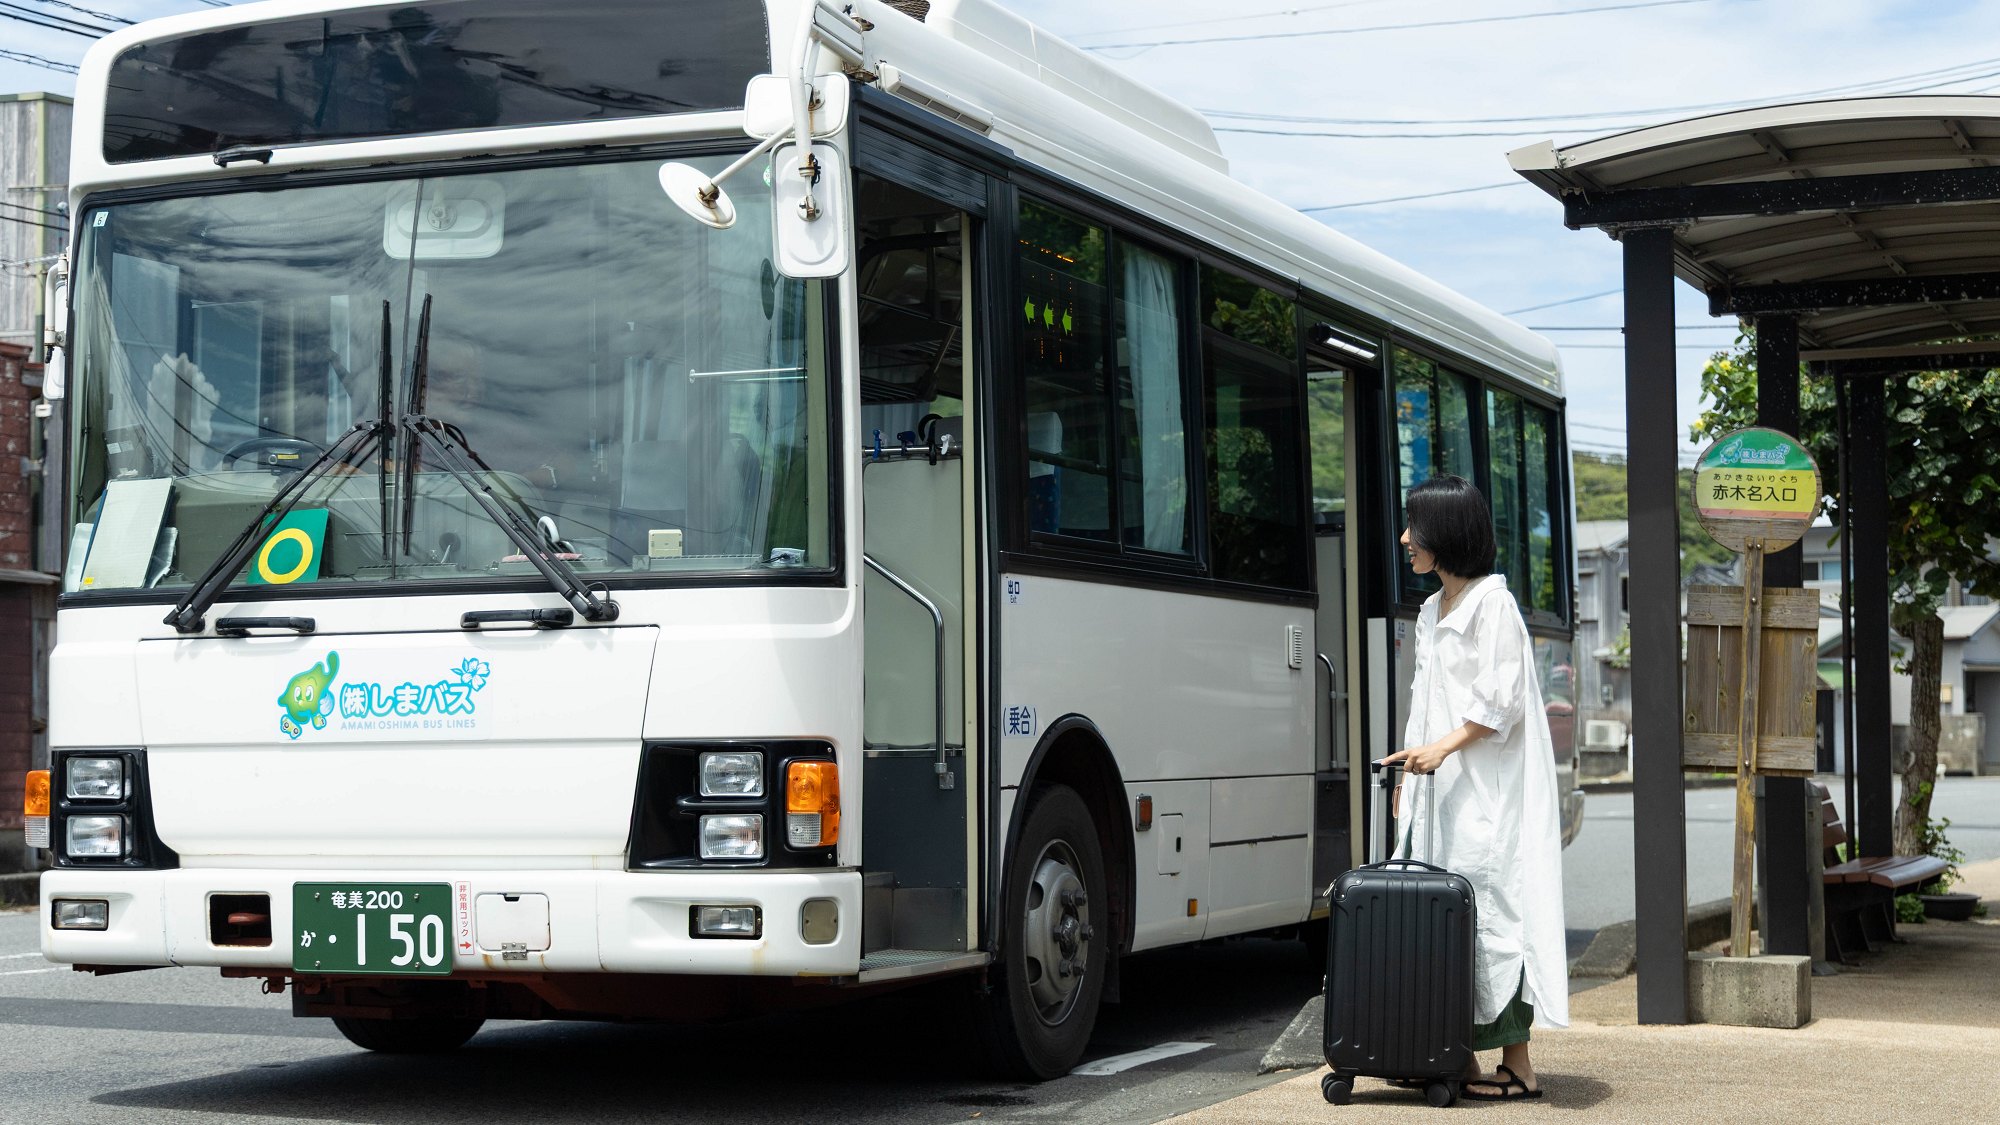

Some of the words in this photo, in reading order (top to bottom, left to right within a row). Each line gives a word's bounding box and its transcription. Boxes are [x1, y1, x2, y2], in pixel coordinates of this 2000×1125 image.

[1712, 484, 1797, 502] 赤木名入口
[1008, 580, 1020, 595] 出口
[340, 720, 376, 730] AMAMI
[378, 720, 419, 730] OSHIMA
[423, 719, 443, 729] BUS
[446, 719, 476, 729] LINES
[1003, 706, 1037, 736] (乗合)
[459, 884, 469, 937] 非常用コック
